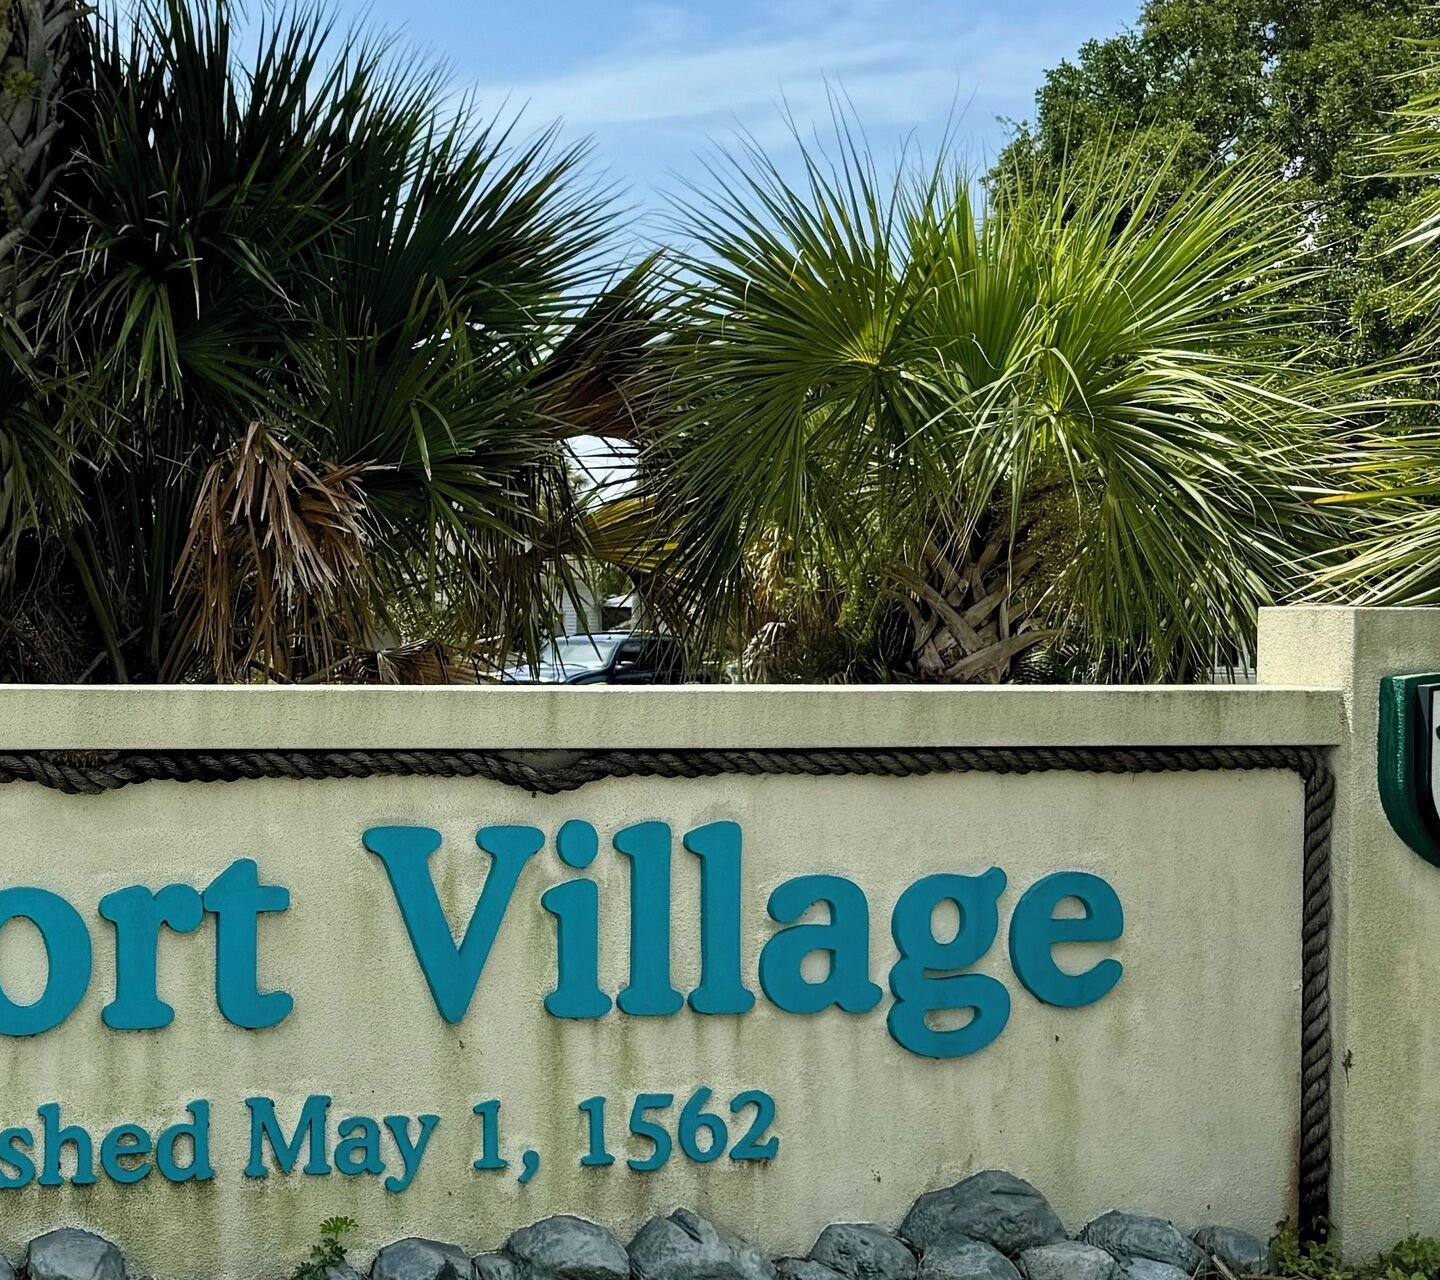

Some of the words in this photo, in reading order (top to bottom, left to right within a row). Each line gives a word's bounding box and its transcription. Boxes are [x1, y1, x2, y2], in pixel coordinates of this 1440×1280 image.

[362, 819, 1124, 1060] Village
[244, 1095, 440, 1193] May
[472, 1099, 541, 1184] 1,
[579, 1086, 780, 1173] 1562
